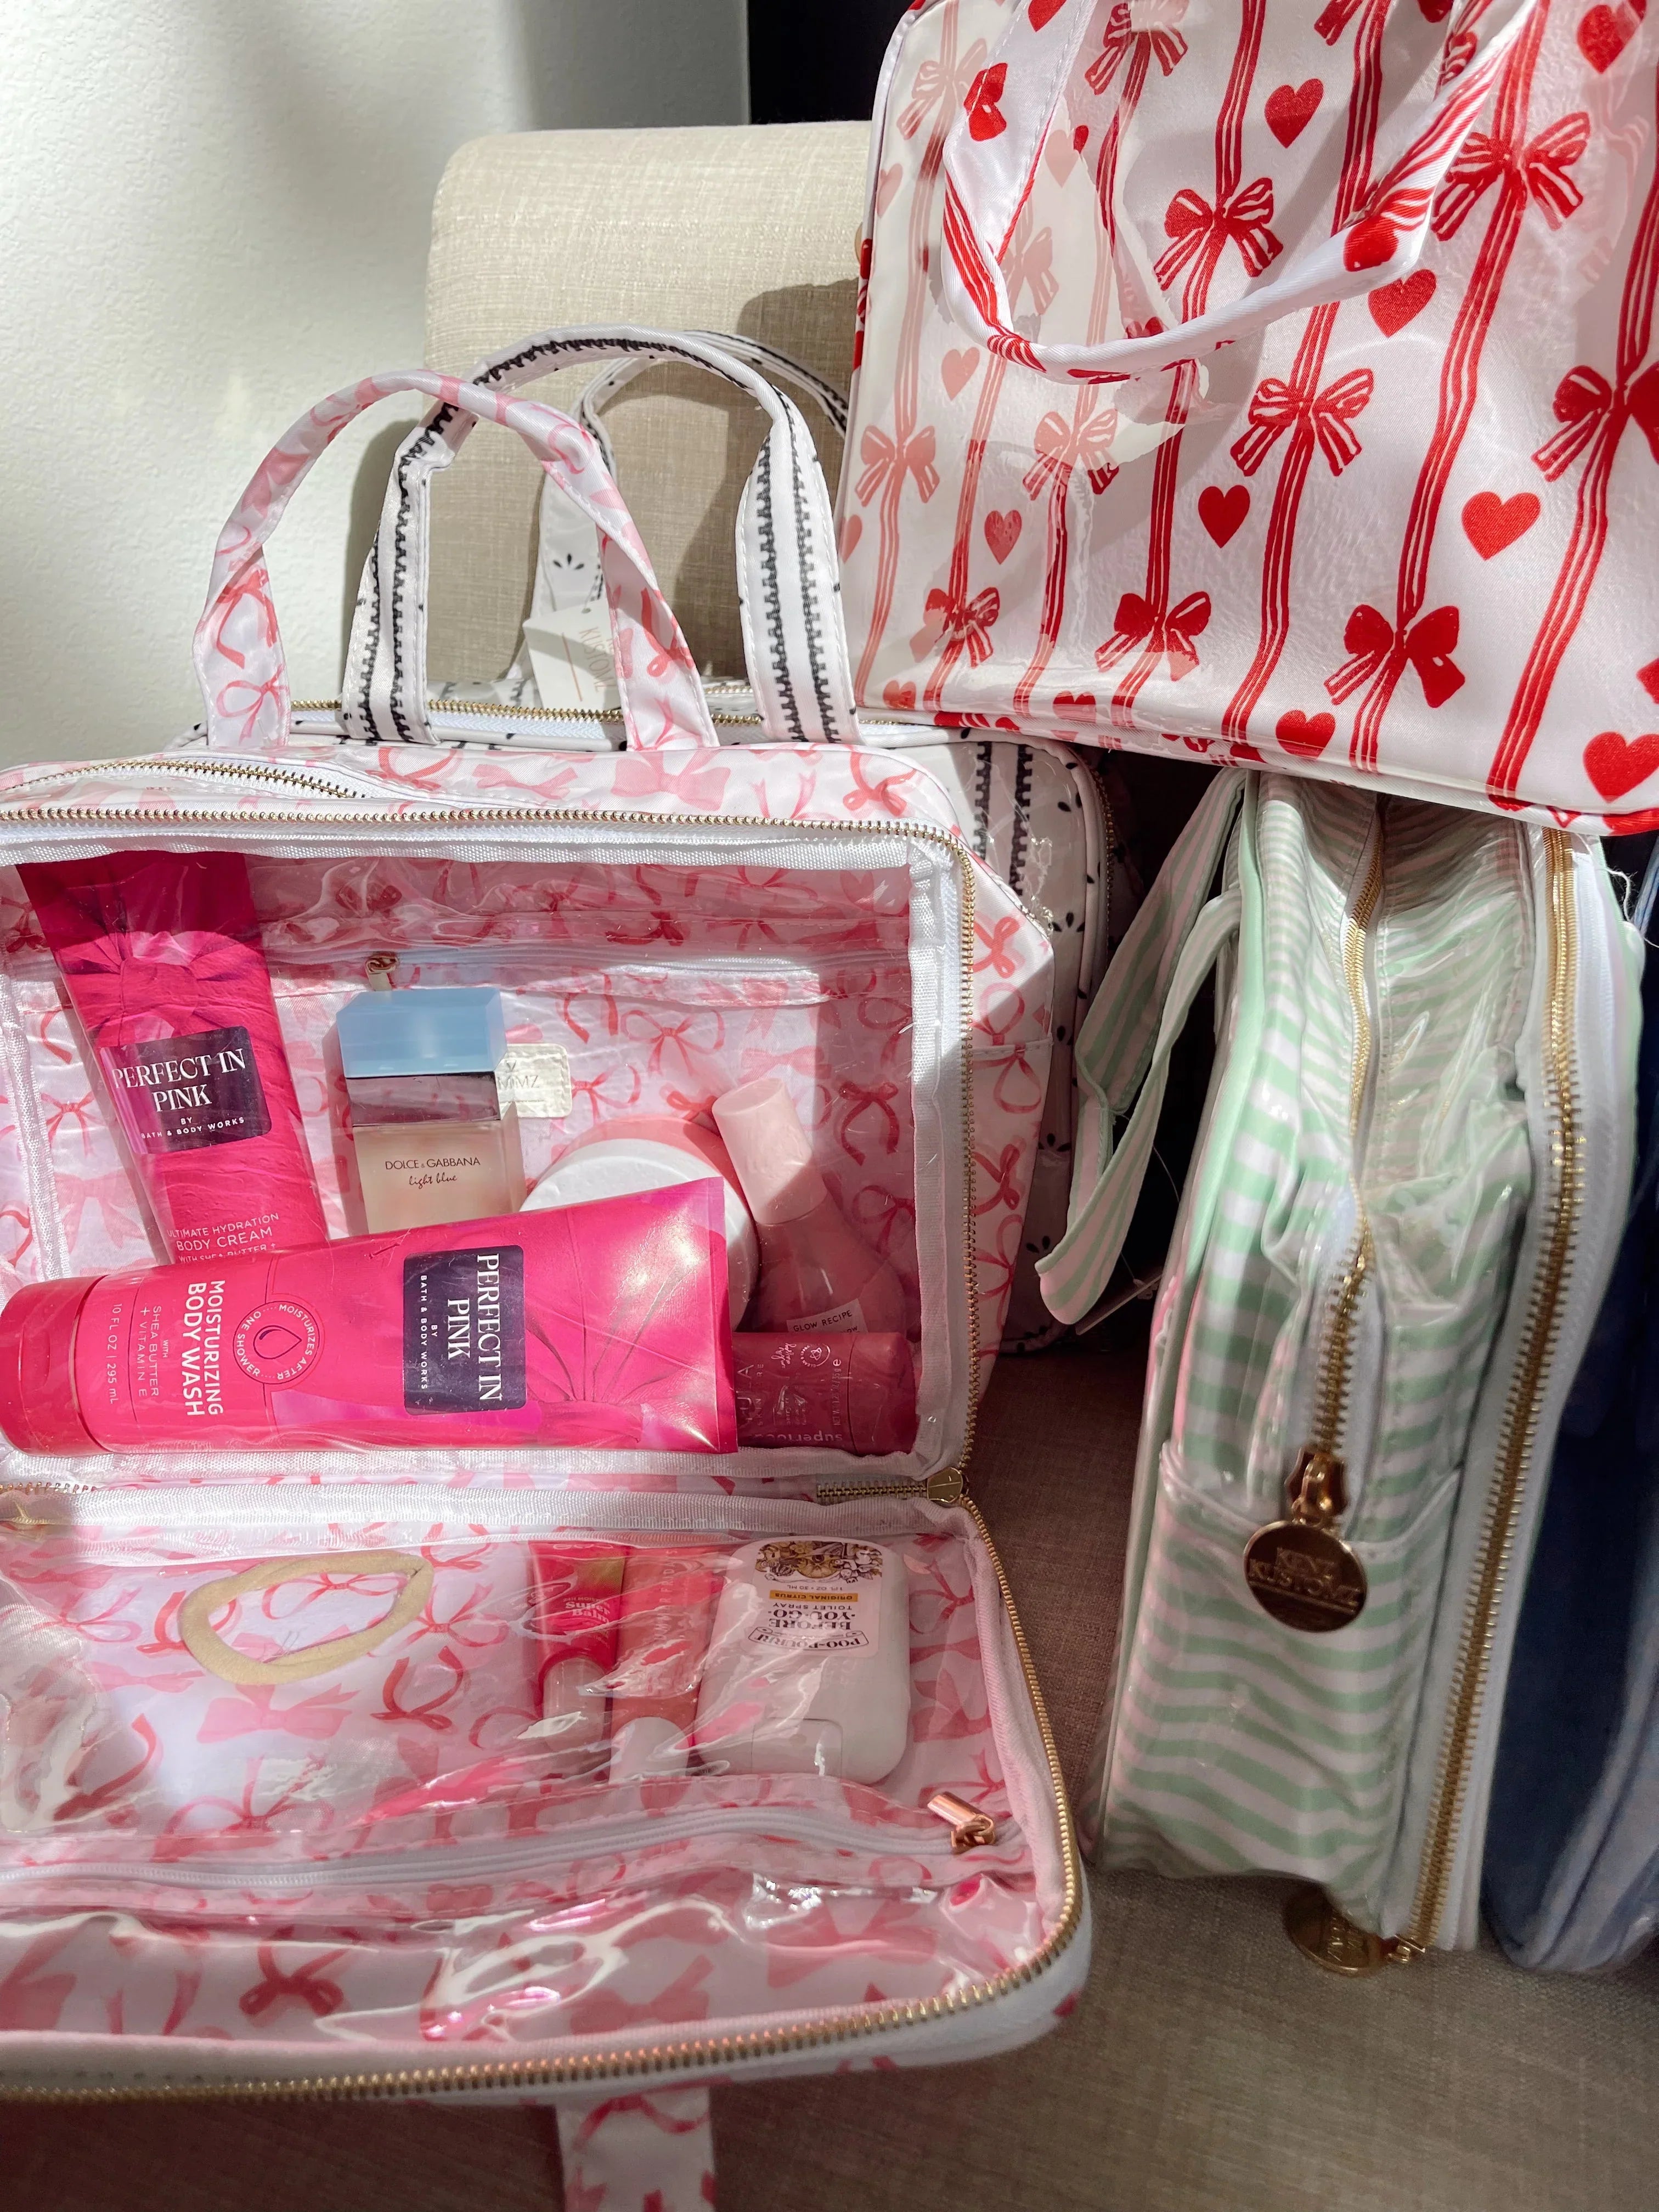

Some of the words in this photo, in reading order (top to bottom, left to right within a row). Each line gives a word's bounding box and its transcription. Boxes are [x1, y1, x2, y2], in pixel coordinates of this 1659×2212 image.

[112, 1054, 211, 1088] PERFECT
[216, 1048, 246, 1074] IN
[151, 1084, 212, 1112] PINK
[176, 1126, 203, 1135] BODY
[207, 1117, 245, 1130] WORKS
[180, 1117, 193, 1125] BY
[385, 1160, 419, 1170] DOLCE
[426, 1156, 481, 1168] GABBANA
[409, 1173, 433, 1189] light
[436, 1172, 458, 1184] blue
[167, 1227, 210, 1238] ULTIMATE
[212, 1212, 279, 1234] HYDRATION
[176, 1239, 210, 1251] BODY
[217, 1226, 273, 1248] CREAM
[112, 1303, 122, 1314] 10
[182, 1282, 207, 1341] BODY
[241, 1311, 262, 1331] ONE
[477, 1253, 501, 1368] PERFECT
[793, 1322, 817, 1332] GLOW
[822, 1310, 853, 1326] RECIPE
[109, 1317, 120, 1330] FL
[150, 1306, 161, 1339] SHEA
[279, 1304, 315, 1356] MOISTURIZES
[431, 1324, 438, 1337] BY
[447, 1297, 471, 1360] PINK
[107, 1334, 117, 1350] OZ
[137, 1321, 148, 1381] VITAMIN
[204, 1280, 225, 1415] MOISTURIZING
[236, 1333, 261, 1376] SHOWER
[107, 1363, 117, 1384] 295
[149, 1344, 159, 1396] BUTTER
[181, 1347, 205, 1415] WASH
[277, 1357, 307, 1380] AFTER
[108, 1388, 119, 1404] mL
[479, 1373, 503, 1401] IN
[572, 1609, 609, 1623] Balm
